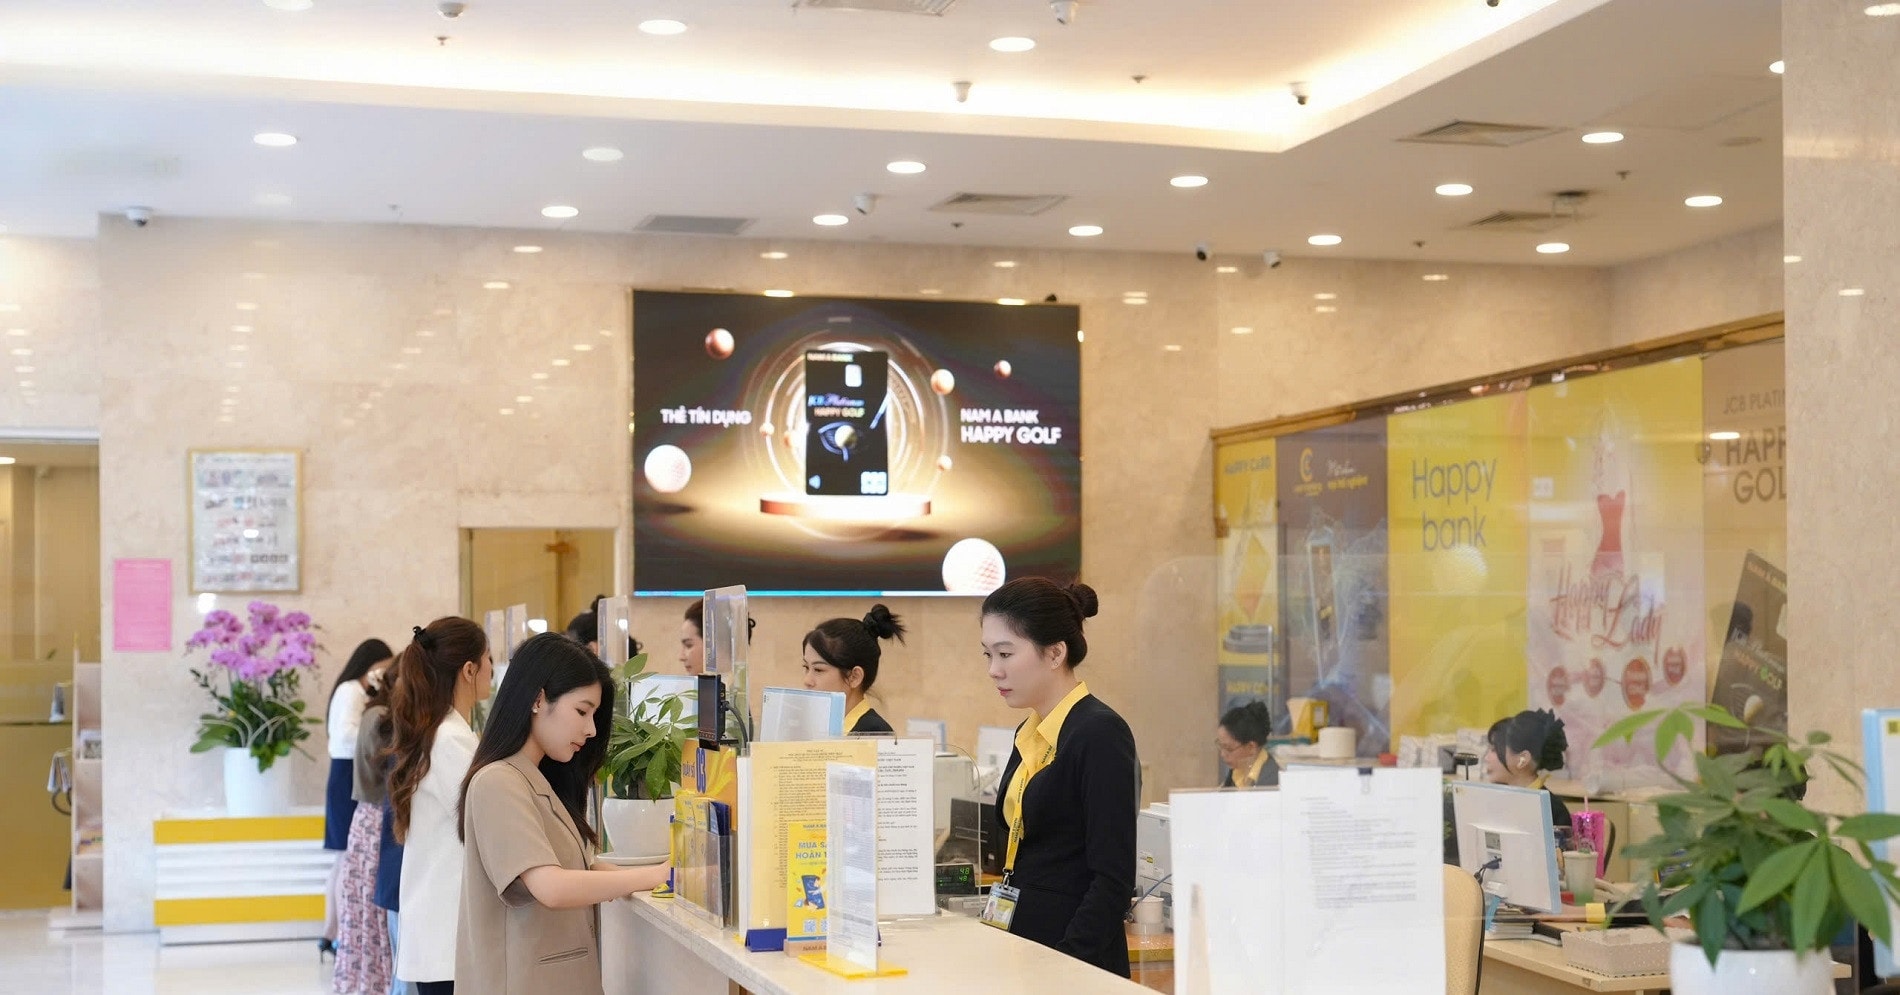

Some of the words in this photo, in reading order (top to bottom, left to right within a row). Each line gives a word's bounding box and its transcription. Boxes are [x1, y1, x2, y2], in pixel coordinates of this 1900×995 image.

[660, 405, 687, 424] THẺ
[688, 406, 712, 424] TÍN
[712, 410, 752, 429] DỤNG
[960, 408, 991, 423] NAM
[992, 409, 1003, 423] A
[1003, 409, 1039, 424] BANK
[960, 425, 1015, 444] HAPPY
[1016, 426, 1062, 444] GOLF
[1411, 457, 1497, 505] Happy
[1422, 506, 1487, 552] bank
[1550, 566, 1612, 642] Happy
[1591, 572, 1664, 669] Lady
